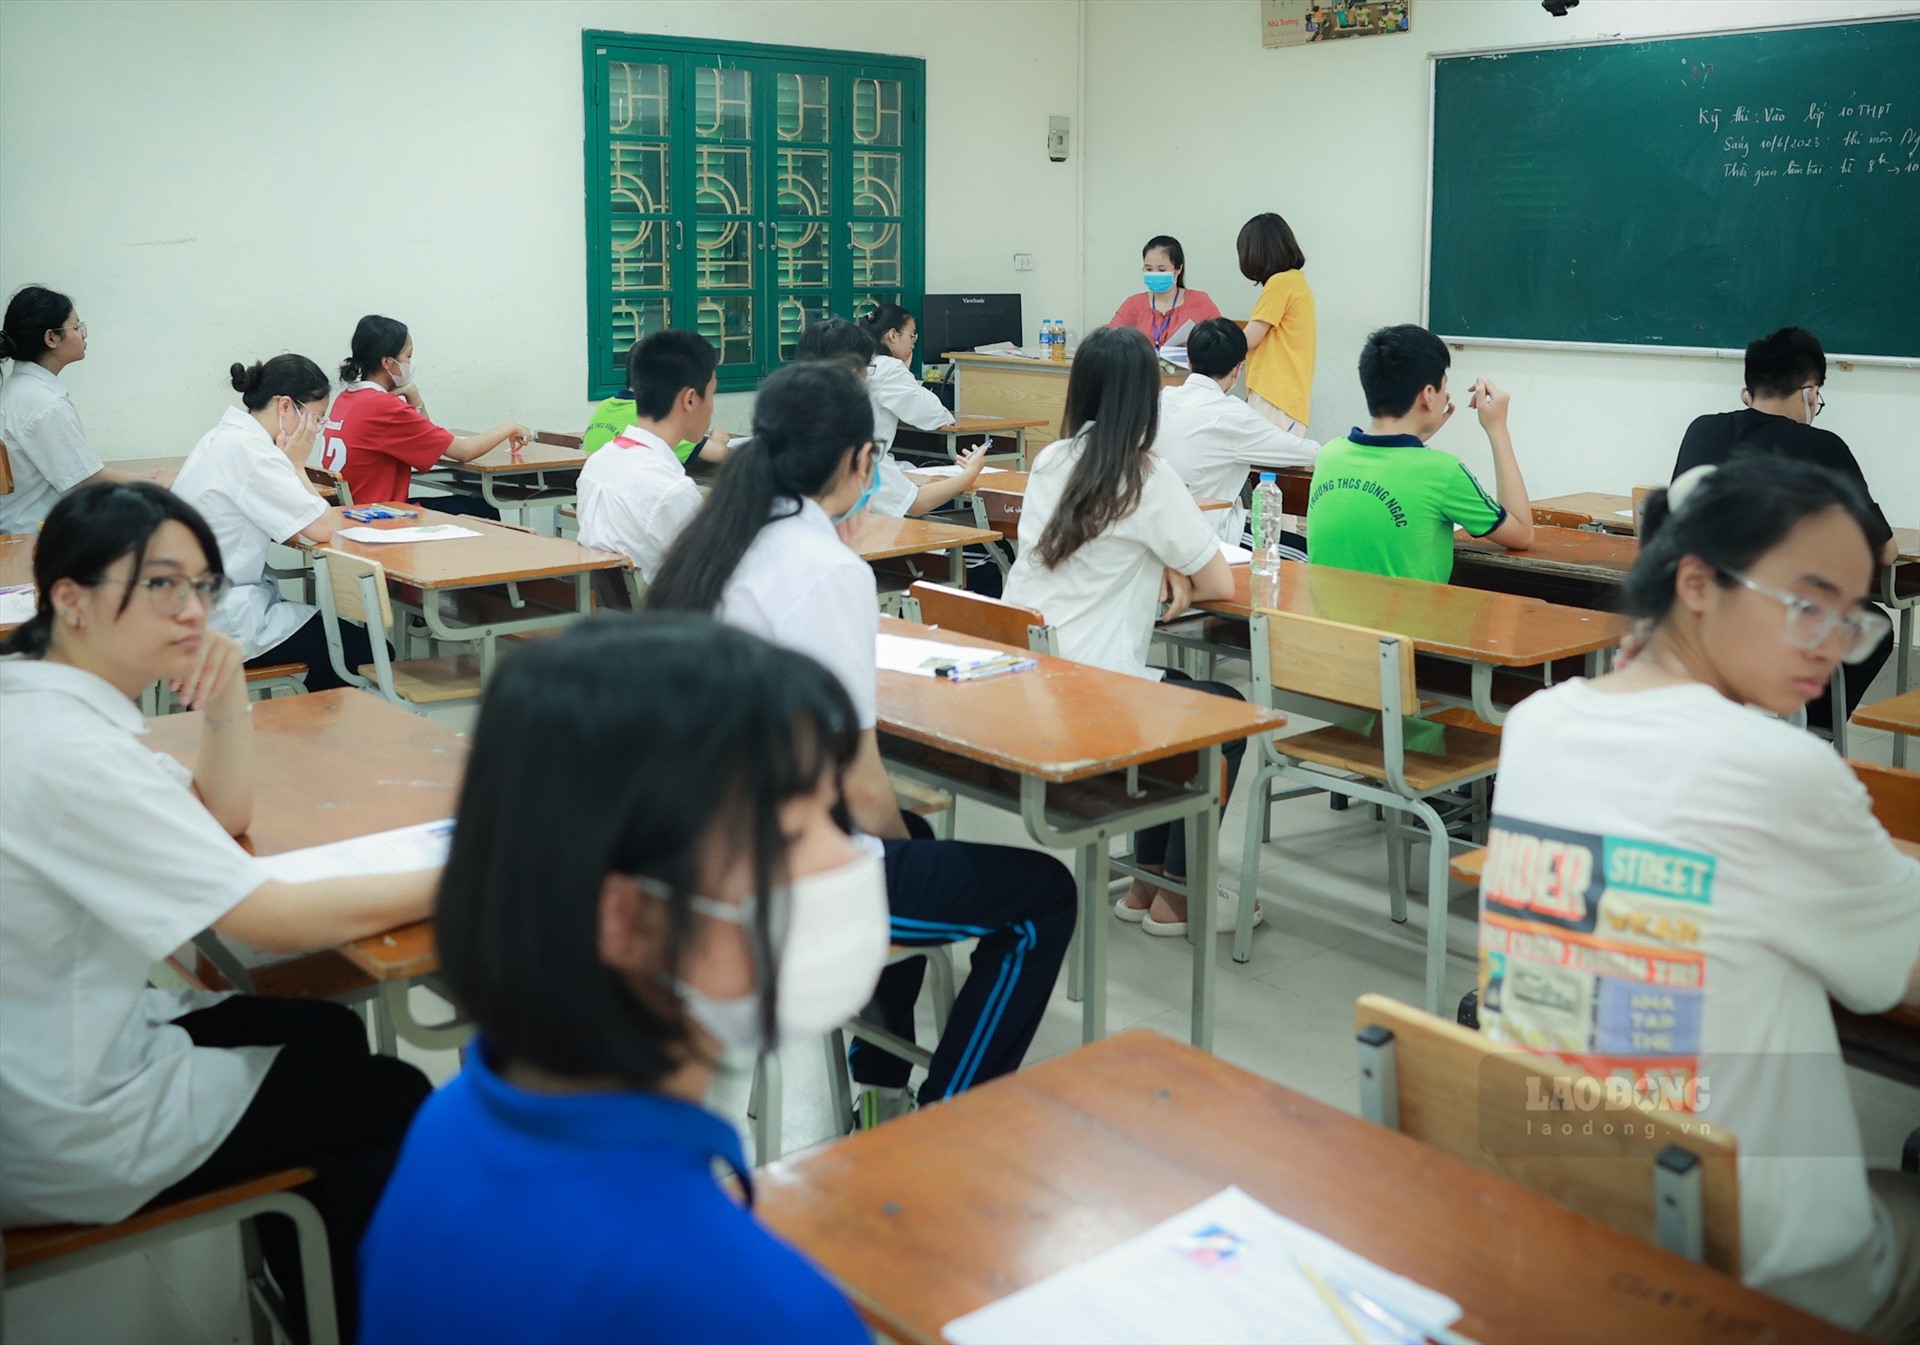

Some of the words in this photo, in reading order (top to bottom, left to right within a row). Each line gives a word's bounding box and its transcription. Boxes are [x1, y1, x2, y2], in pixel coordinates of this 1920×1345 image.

[1838, 106, 1854, 117] 10
[1858, 102, 1893, 119] THPT
[1843, 130, 1863, 147] thi
[1754, 165, 1777, 187] gian
[1337, 478, 1362, 489] THCS
[1362, 480, 1389, 501] ĐỒNG
[1385, 498, 1408, 528] NGẠC
[1609, 846, 1711, 898] STREET
[1604, 907, 1701, 944] WEAR
